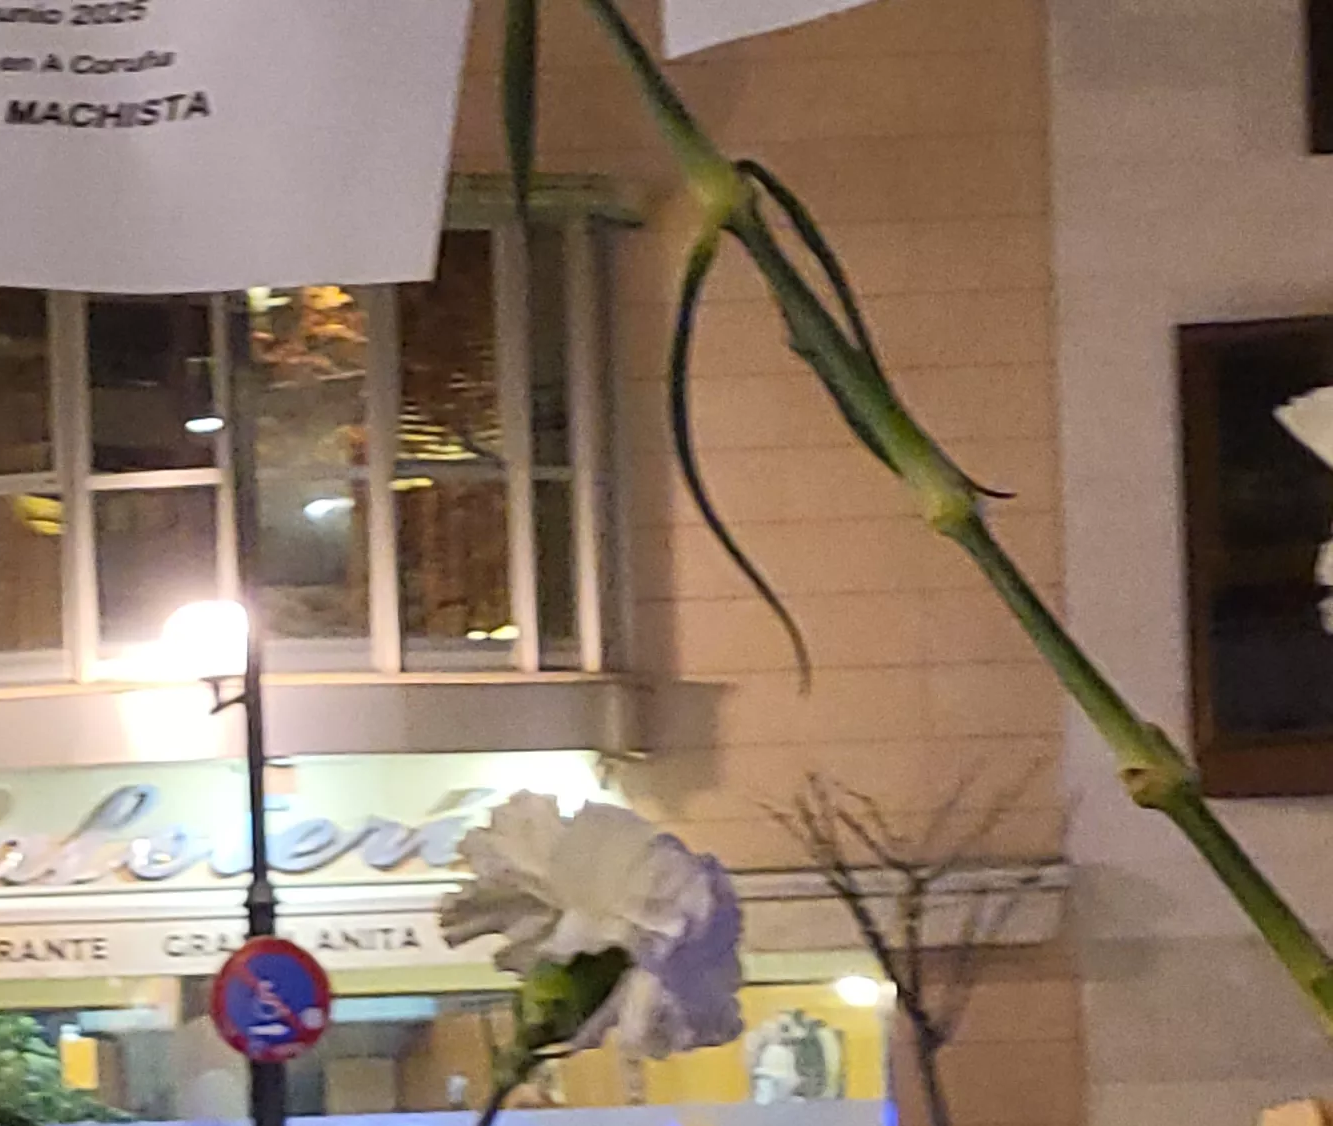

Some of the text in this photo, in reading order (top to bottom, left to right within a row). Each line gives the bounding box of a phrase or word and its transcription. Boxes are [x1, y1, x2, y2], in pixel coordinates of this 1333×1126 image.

[70, 0, 146, 26] 2025
[40, 53, 65, 73] A
[4, 91, 212, 130] MACHISTA
